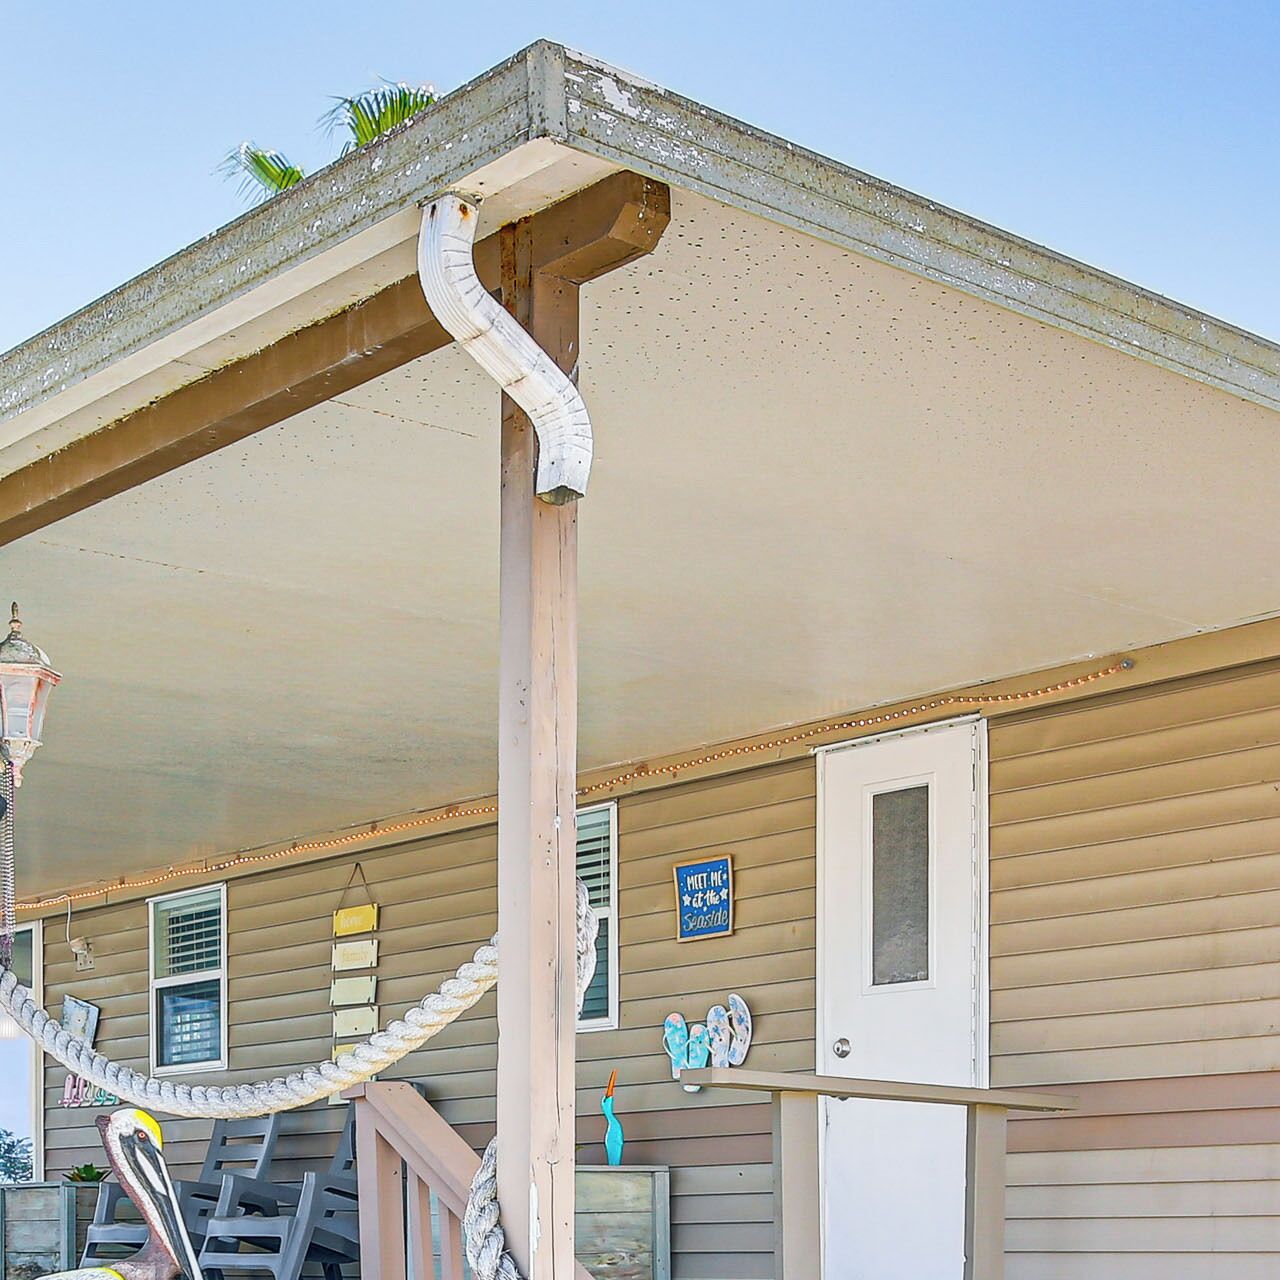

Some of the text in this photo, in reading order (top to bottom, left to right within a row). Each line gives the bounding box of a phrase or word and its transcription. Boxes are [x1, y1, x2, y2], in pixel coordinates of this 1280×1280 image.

[687, 870, 723, 891] MEET ME
[692, 889, 720, 908] at the
[684, 907, 729, 931] Seaside
